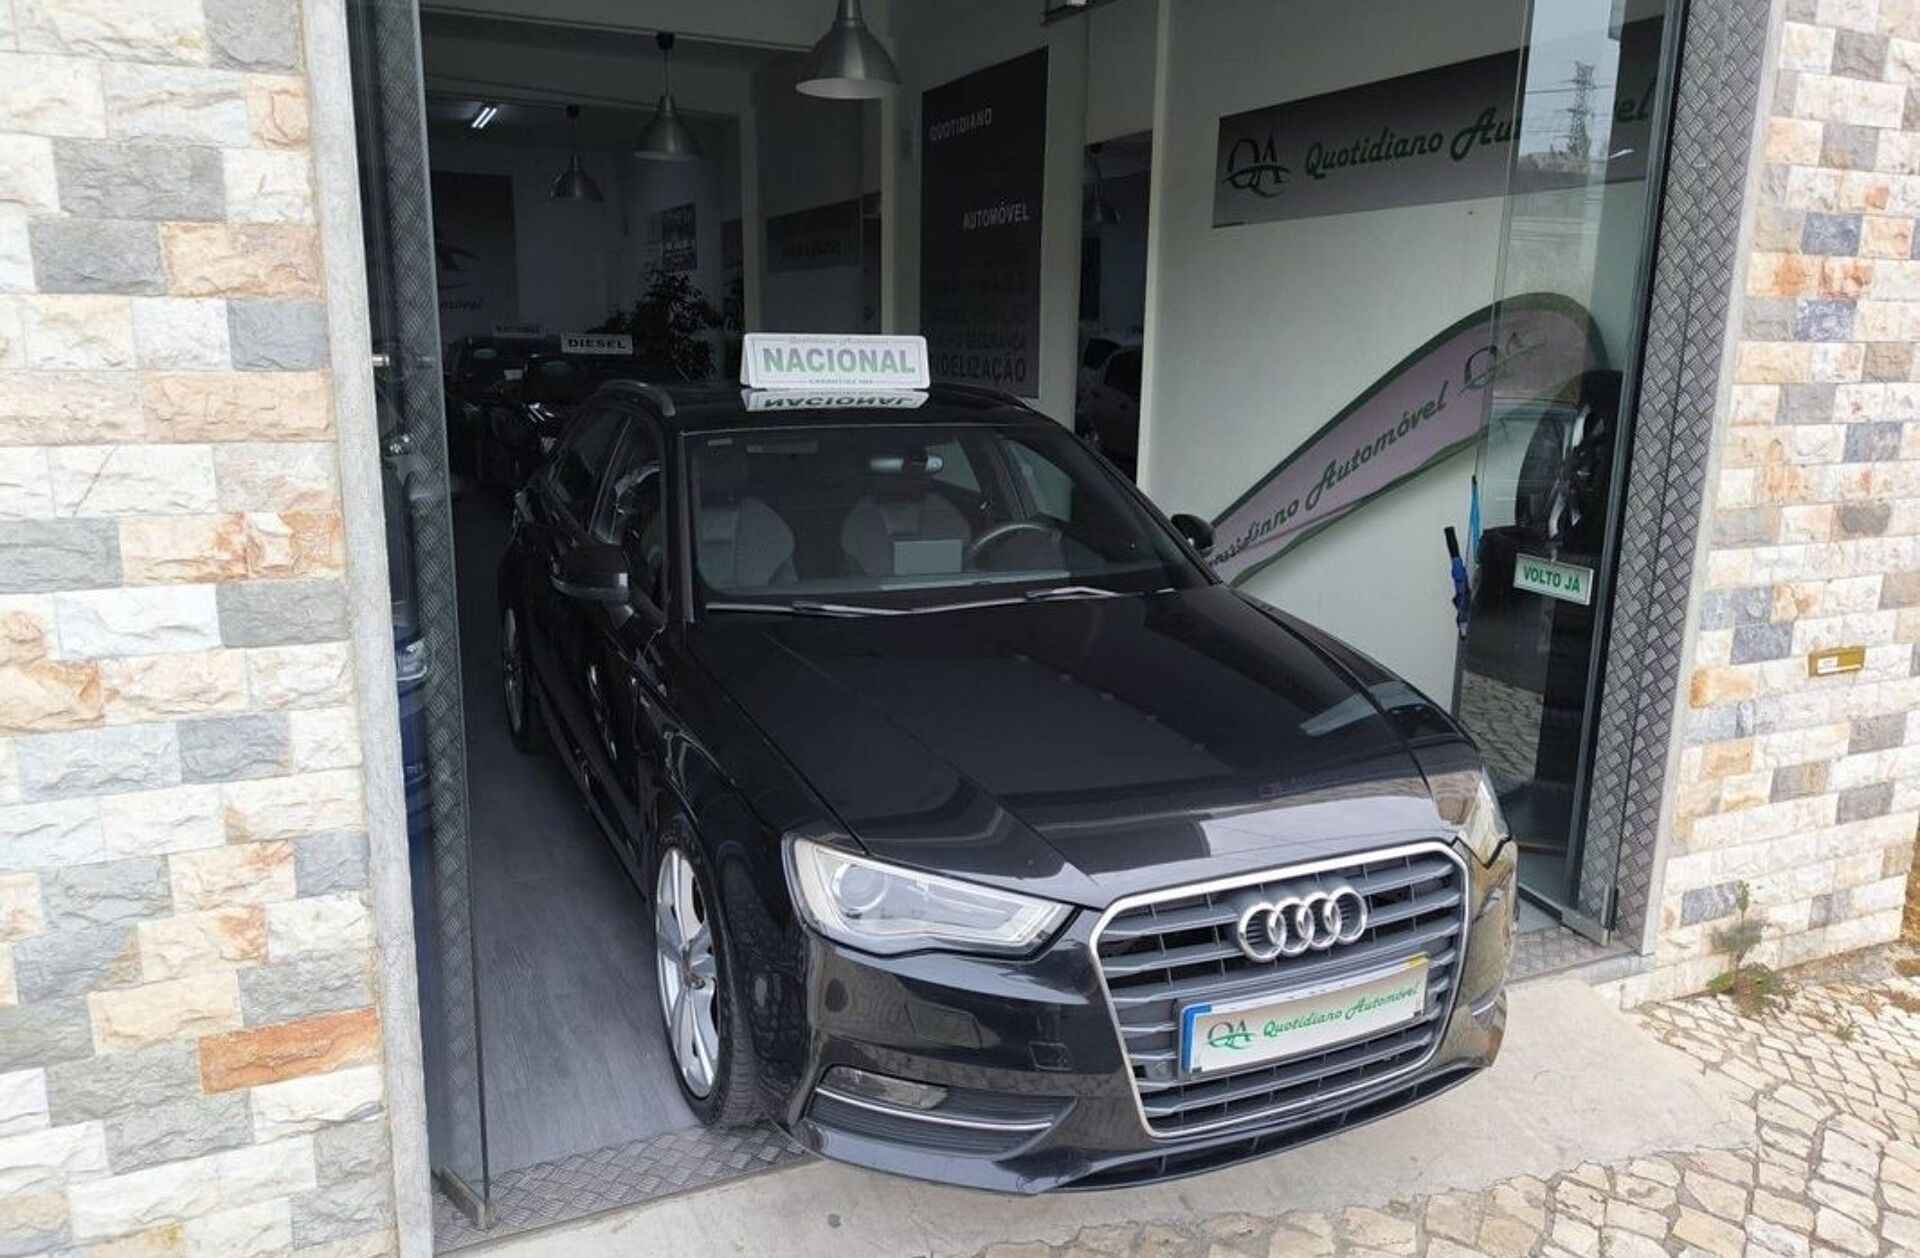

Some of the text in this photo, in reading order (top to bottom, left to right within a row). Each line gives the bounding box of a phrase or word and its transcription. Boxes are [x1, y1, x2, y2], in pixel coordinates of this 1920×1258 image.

[929, 108, 993, 142] QUOTIDIANO
[1304, 126, 1442, 179] Quotidiano
[962, 201, 1031, 230] AUTOMÓVEL
[568, 339, 627, 350] DIESEL
[763, 348, 916, 373] NACIONAL
[1305, 381, 1449, 511] Automóvel
[1523, 565, 1561, 587] VOLTO
[1263, 1010, 1343, 1037] Quotidiano
[1345, 981, 1421, 1019] Automóvel
